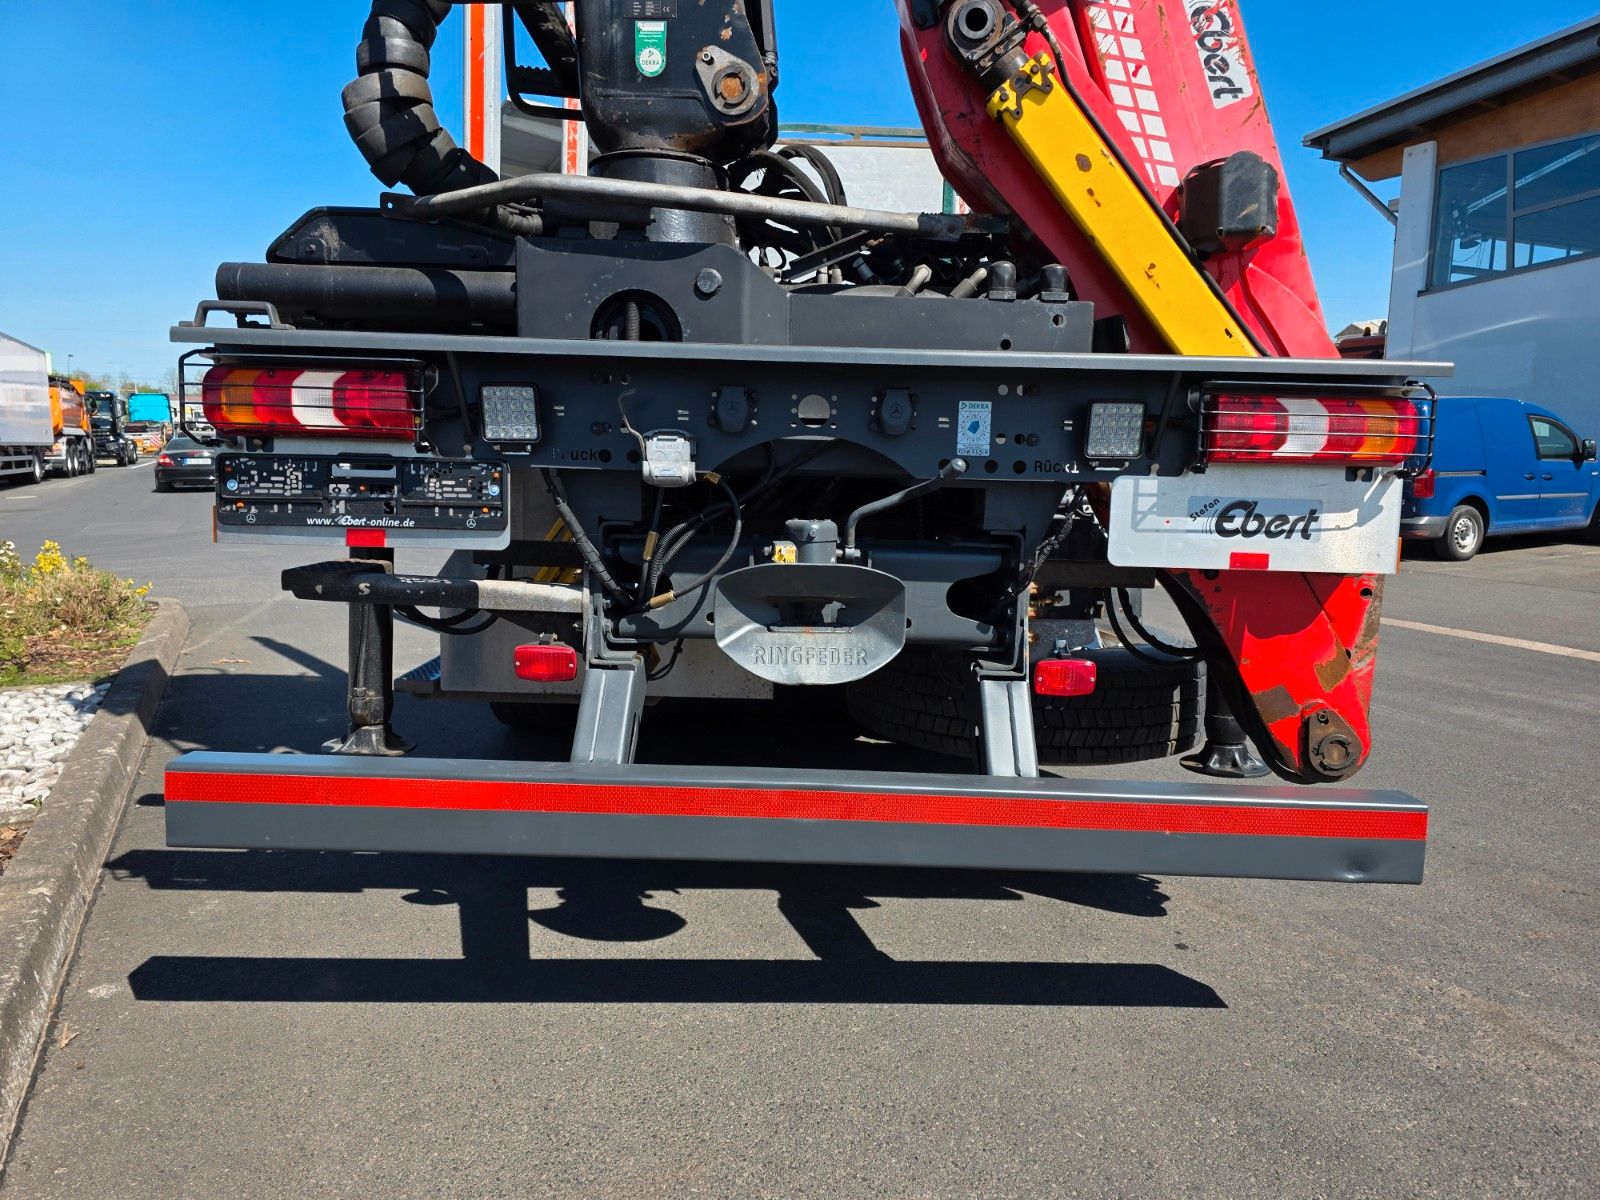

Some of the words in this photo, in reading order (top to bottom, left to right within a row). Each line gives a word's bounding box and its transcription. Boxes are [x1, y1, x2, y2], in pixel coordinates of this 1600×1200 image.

[1189, 498, 1220, 522] Stefan
[1214, 499, 1321, 541] Ebert
[306, 515, 415, 528] www.Ebert-online.de
[753, 645, 869, 666] RINGFEDER
